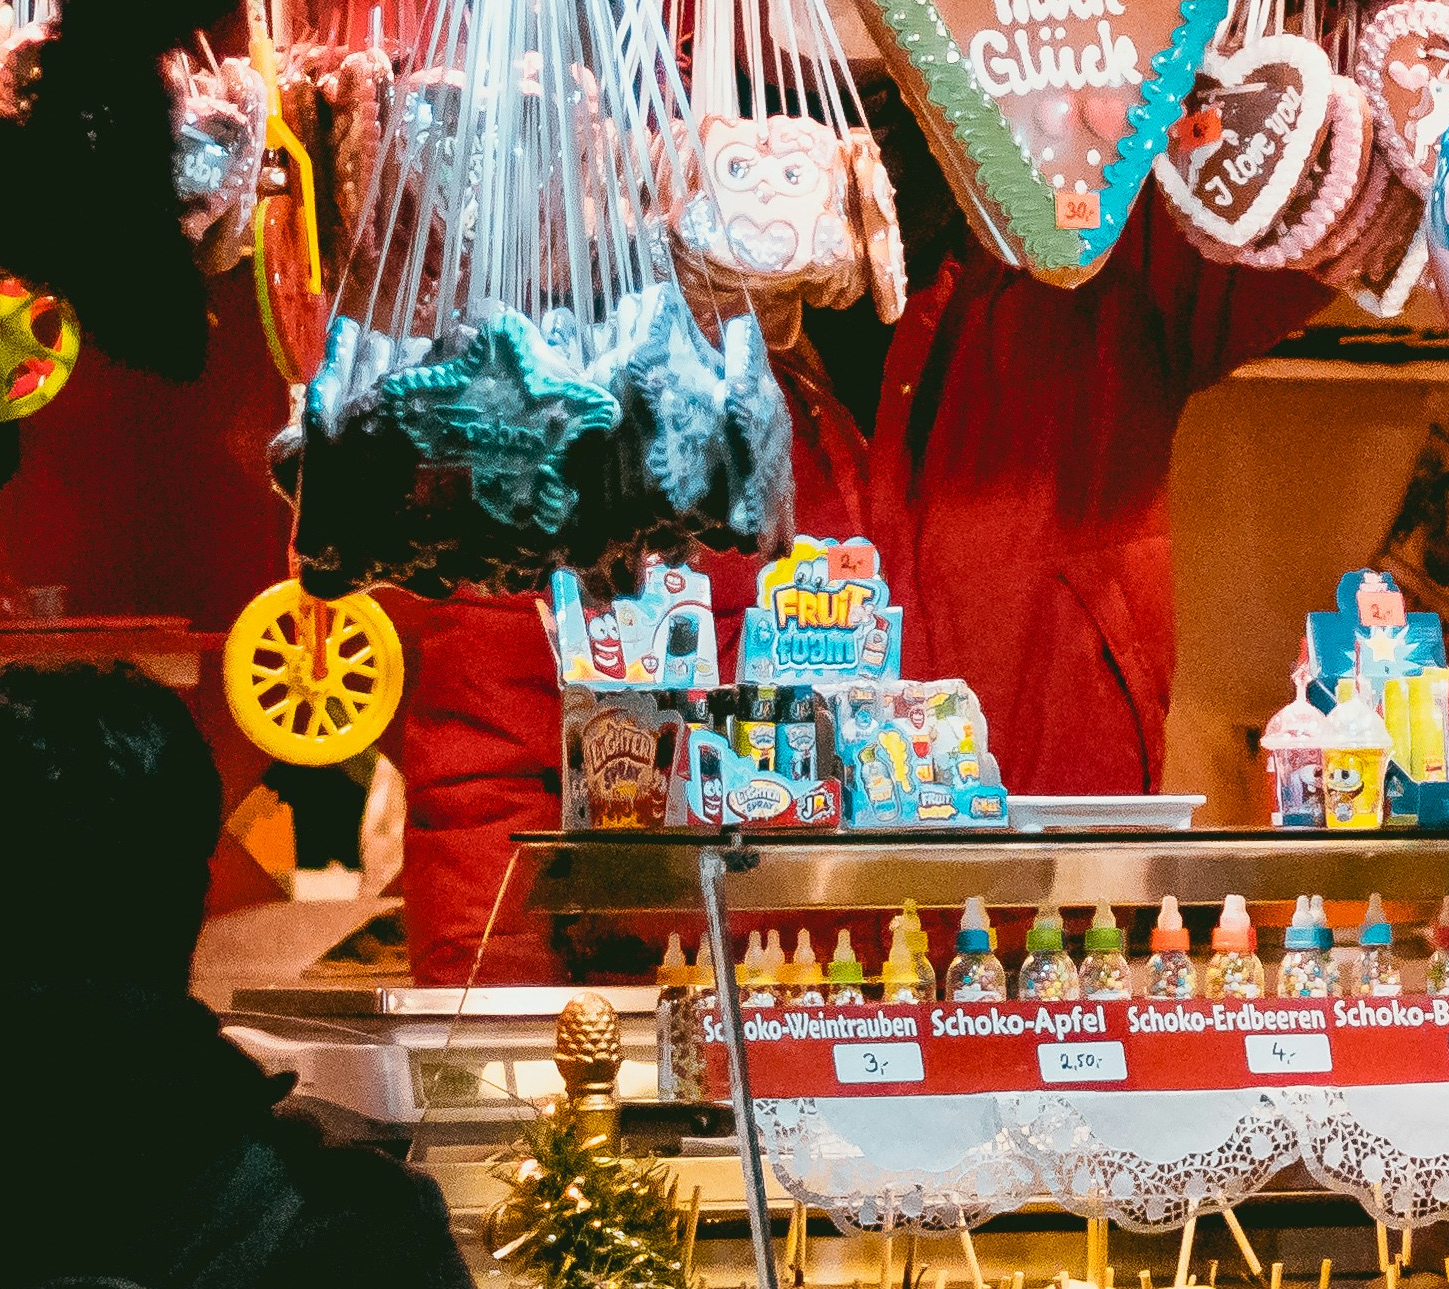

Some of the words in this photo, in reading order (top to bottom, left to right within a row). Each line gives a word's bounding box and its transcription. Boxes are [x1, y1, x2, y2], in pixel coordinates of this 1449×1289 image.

[969, 22, 1142, 95] Glück
[1205, 176, 1232, 205] I
[1223, 133, 1275, 184] love
[1265, 86, 1302, 144] you
[703, 1008, 917, 1043] Scoko-Weintrauben
[931, 1006, 1107, 1041] Schoko-Apfel
[1127, 1004, 1326, 1034] Schoko-Erdbeeren
